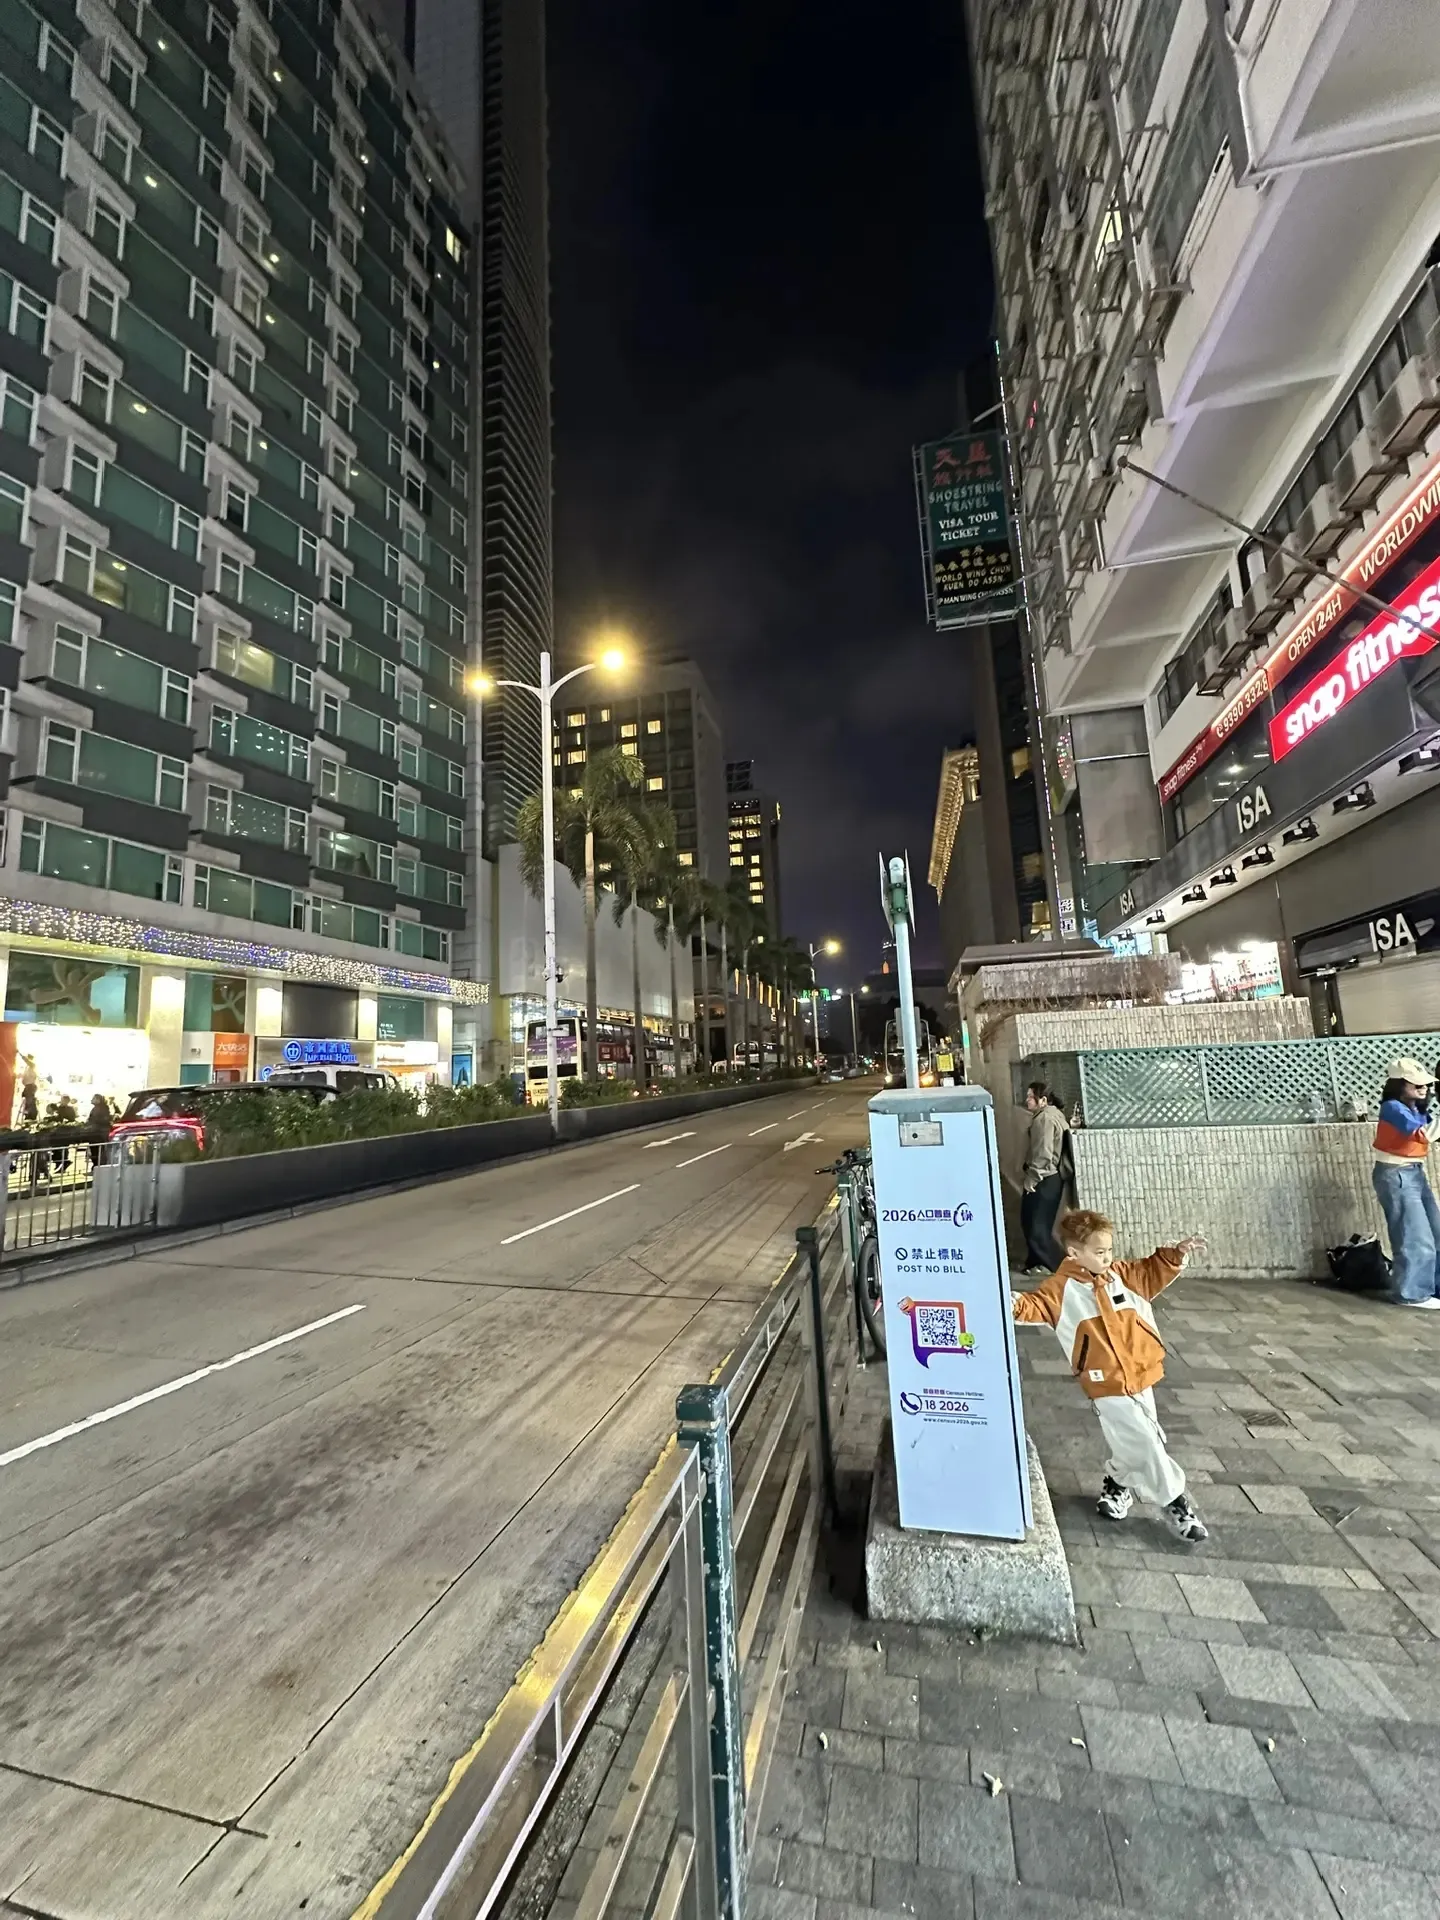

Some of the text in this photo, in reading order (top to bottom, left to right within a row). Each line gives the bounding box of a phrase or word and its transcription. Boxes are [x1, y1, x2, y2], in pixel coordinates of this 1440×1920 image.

[928, 480, 1002, 504] SHOESTRING
[944, 496, 989, 513] TRAVEL
[939, 511, 999, 529] VISA TOUR
[941, 526, 980, 541] TICKET
[935, 565, 1012, 584] WORLD WING CHUN
[943, 581, 964, 592] KUEN
[968, 579, 979, 587] DO
[944, 596, 960, 604] MAN
[960, 592, 977, 602] WING
[1287, 594, 1343, 662] OPEN 24H
[1285, 578, 1440, 745] snap fitnes
[1223, 702, 1244, 731] 9390
[1164, 774, 1179, 796] snap
[1176, 752, 1197, 782] fitness
[1235, 786, 1272, 834] ISA
[1120, 888, 1136, 916] ISA
[1369, 912, 1416, 953] ISA
[912, 1248, 963, 1260] 禁止標貼
[897, 1265, 966, 1274] POST NO BILL
[925, 1400, 969, 1412] 18 2026
